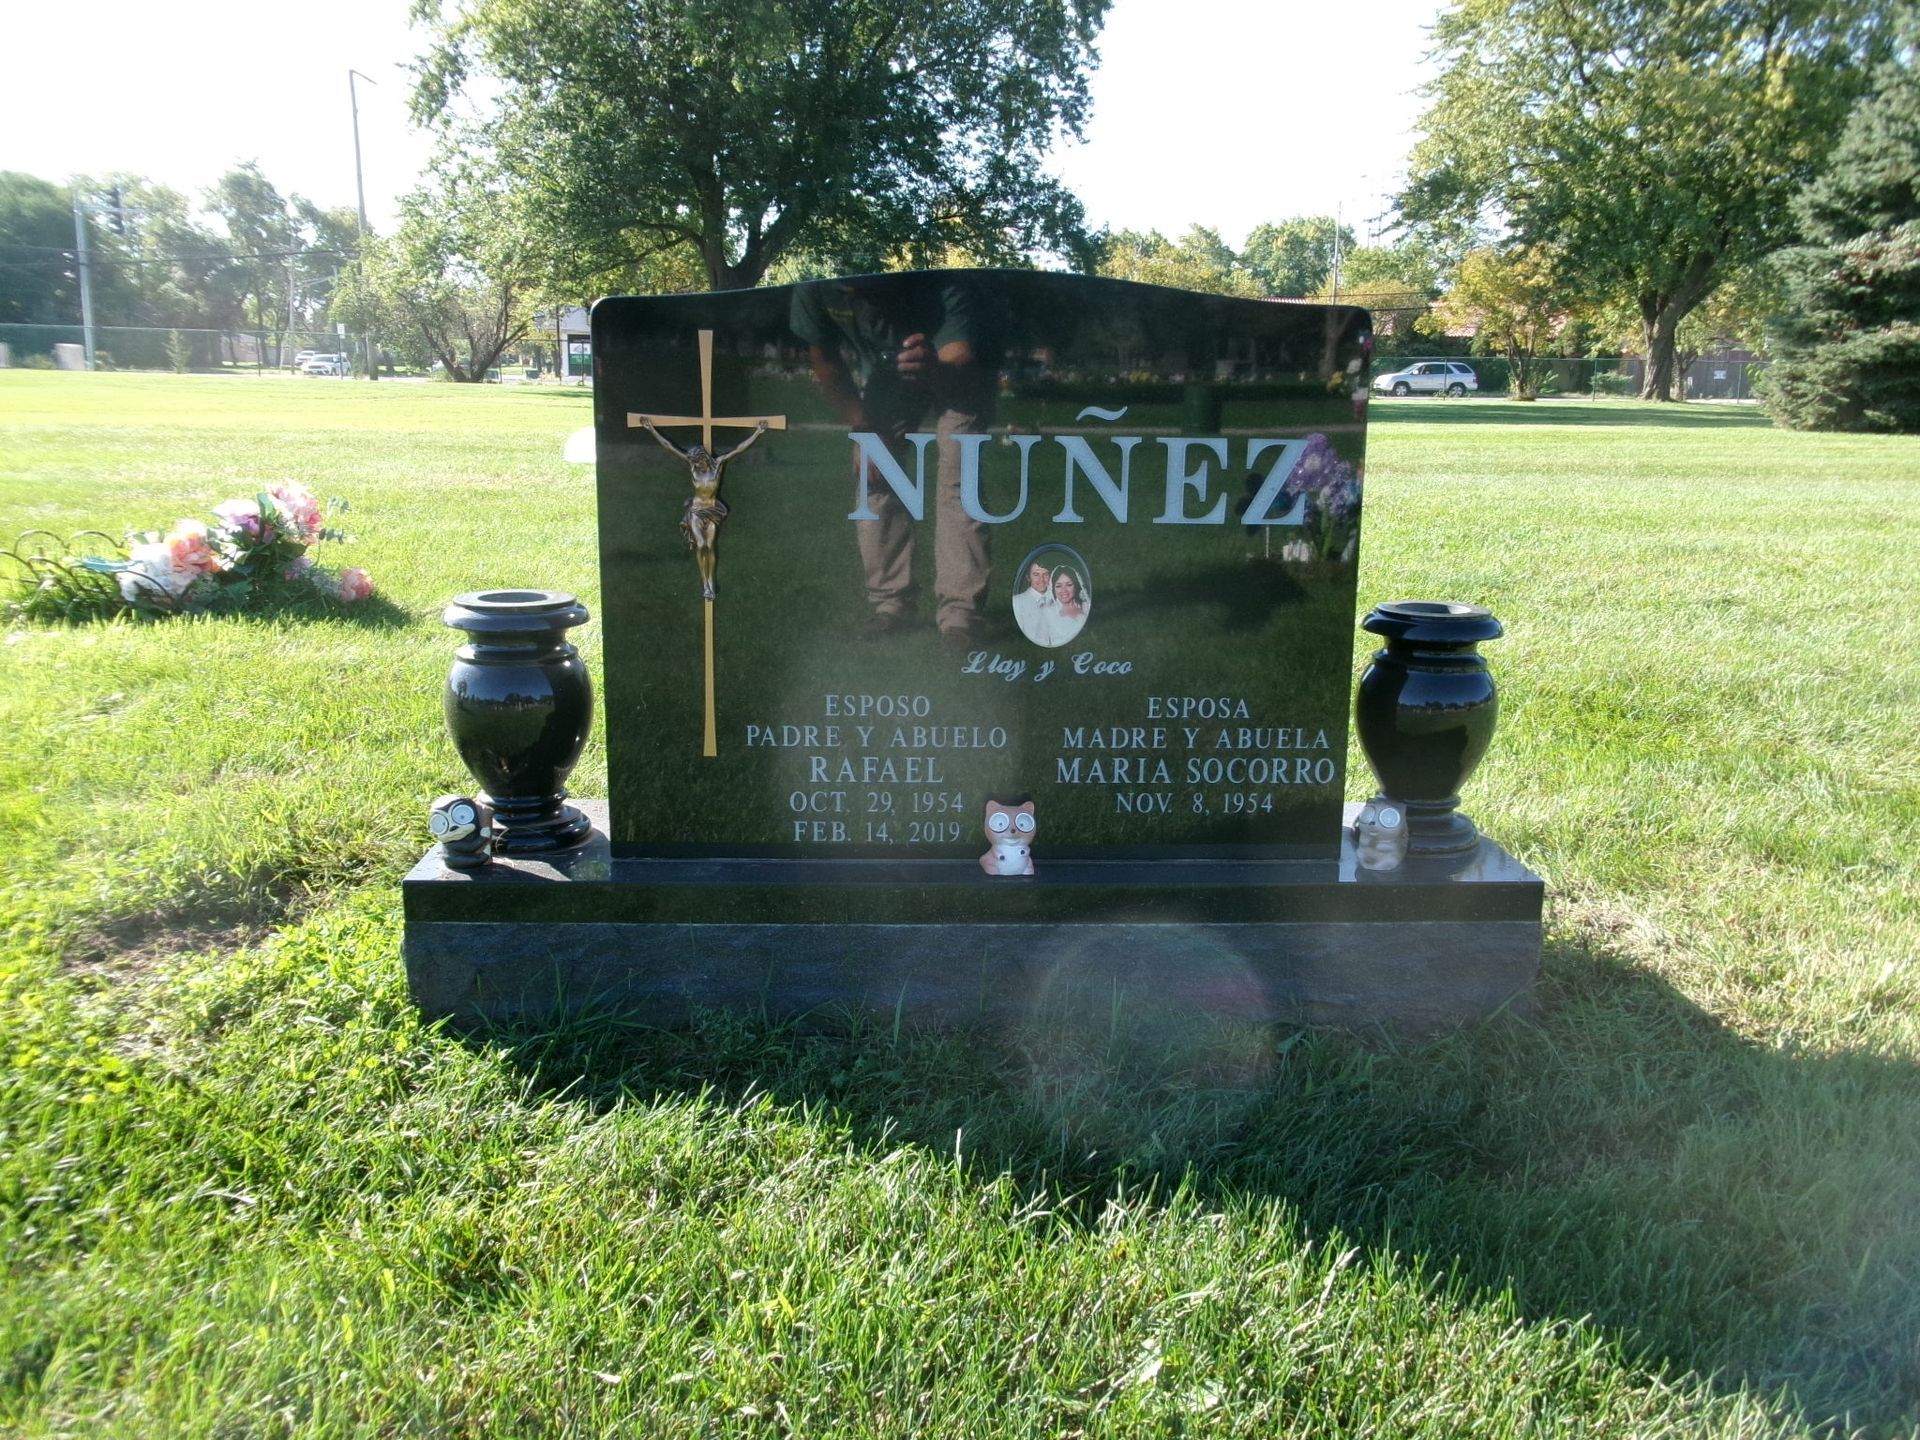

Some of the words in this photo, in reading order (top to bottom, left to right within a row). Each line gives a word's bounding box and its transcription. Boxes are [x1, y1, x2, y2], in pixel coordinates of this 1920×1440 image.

[847, 405, 1309, 526] NUÑEZ
[1034, 660, 1055, 682] y
[1071, 652, 1133, 675] Coco
[825, 694, 931, 717] ESPOSO
[1146, 696, 1251, 719] ESPOSA
[746, 725, 841, 748] PADRE
[856, 726, 873, 747] Y
[890, 726, 1007, 749] ABUELO
[1062, 727, 1167, 749] MADRE
[1184, 727, 1201, 749] Y
[1215, 727, 1330, 749] ABUELA
[809, 756, 944, 783] RAFAEL
[1055, 757, 1172, 784] MARIA
[1186, 757, 1335, 784] SOCORRO
[789, 791, 849, 813] OCT.
[867, 791, 896, 815] 29,
[913, 792, 964, 813] 1954
[1115, 793, 1174, 814] NOV.
[1192, 793, 1210, 816] 8,
[1223, 793, 1273, 814] 1954
[793, 820, 852, 842] FEB.
[867, 821, 894, 844] 14,
[909, 821, 960, 842] 2019
